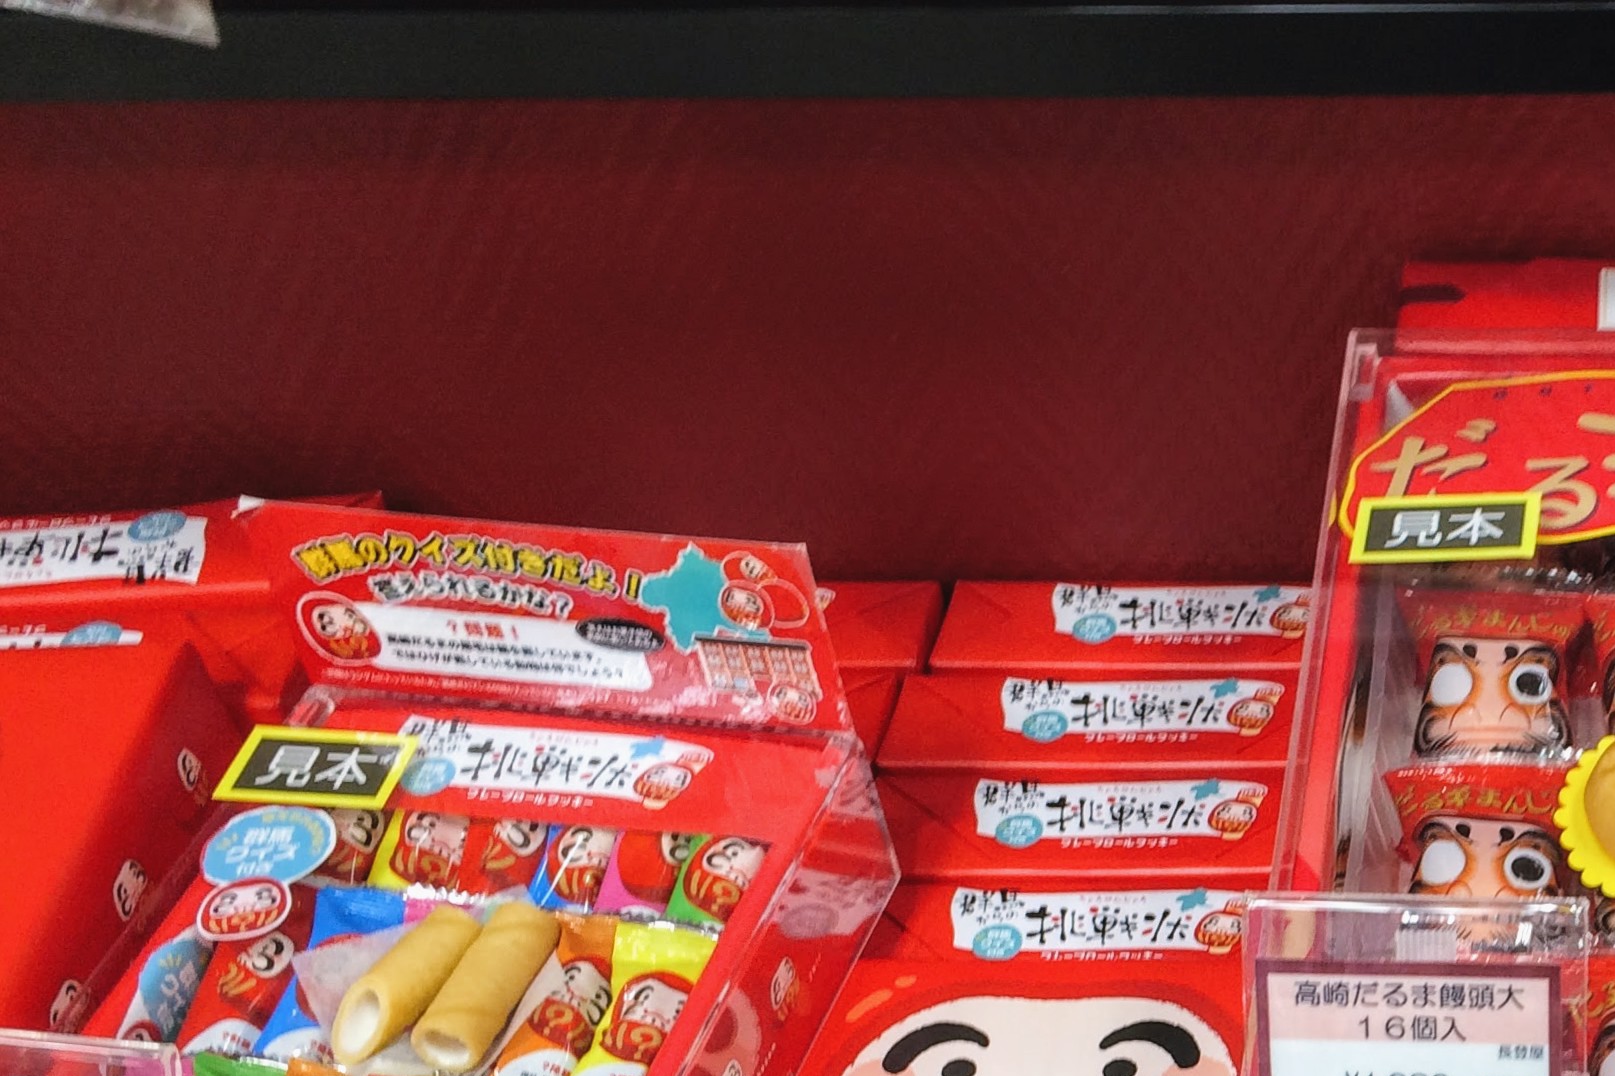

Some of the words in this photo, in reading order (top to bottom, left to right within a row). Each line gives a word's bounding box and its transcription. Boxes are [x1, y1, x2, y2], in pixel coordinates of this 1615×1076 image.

[1389, 508, 1504, 544] 見本
[255, 745, 379, 791] 見本
[1294, 981, 1525, 1011] 高崎だるま饅頭大
[1358, 1016, 1466, 1041] 16個入
